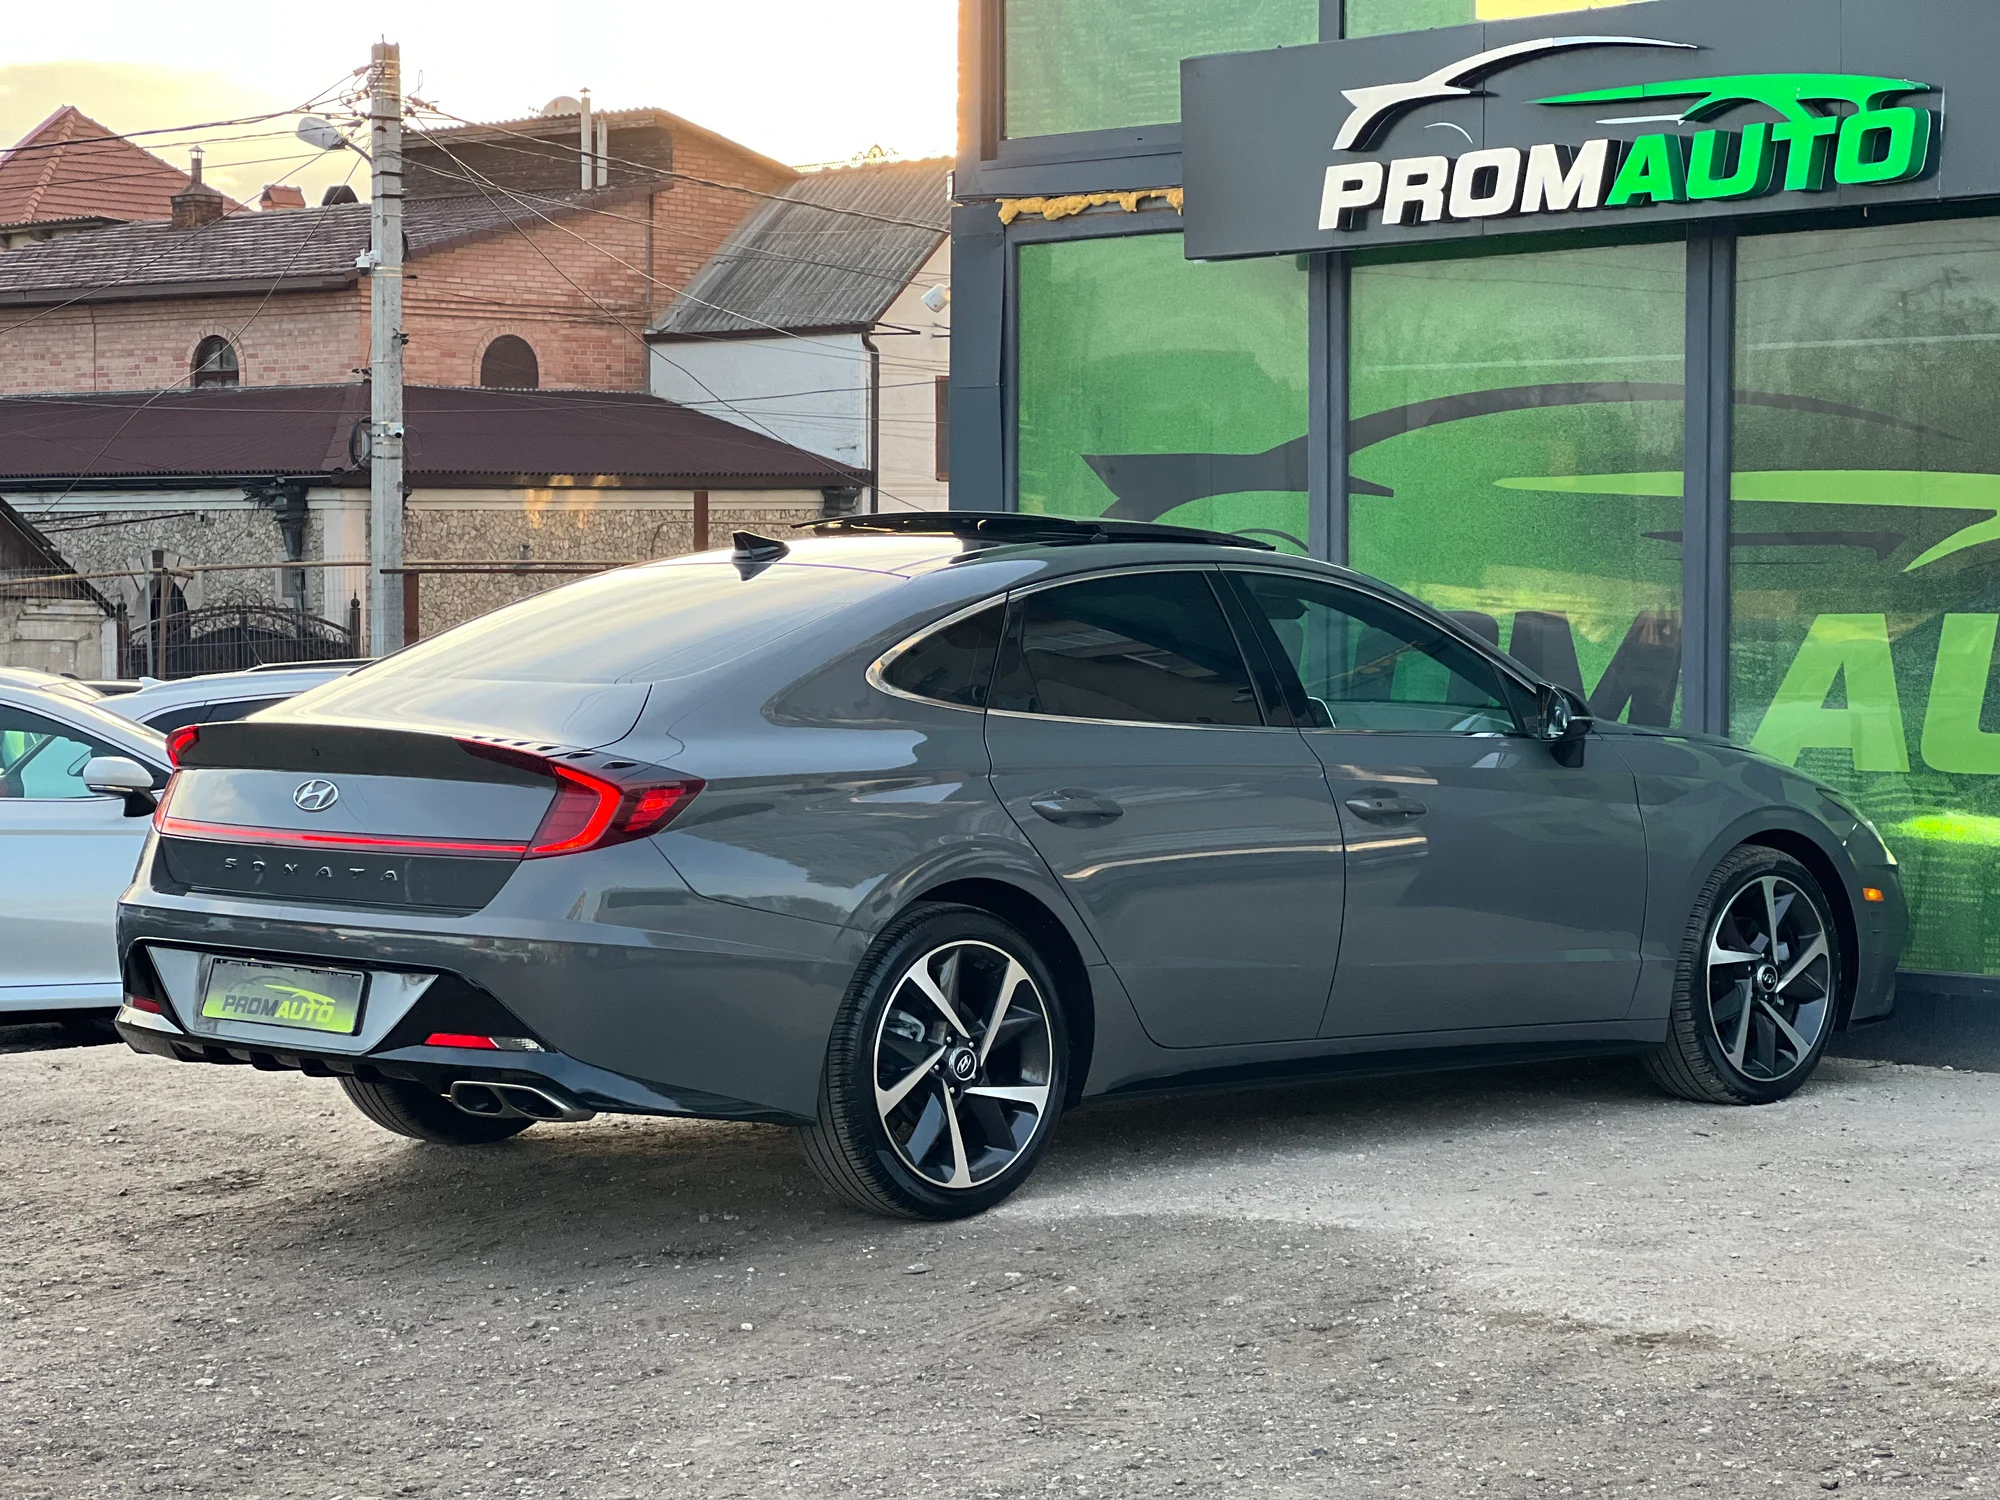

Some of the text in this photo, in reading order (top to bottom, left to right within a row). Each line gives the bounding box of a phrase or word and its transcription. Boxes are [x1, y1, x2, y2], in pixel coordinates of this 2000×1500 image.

[1318, 105, 1930, 230] PROMAUTO
[224, 857, 398, 881] SONATA
[221, 994, 335, 1023] PROMAUTO
